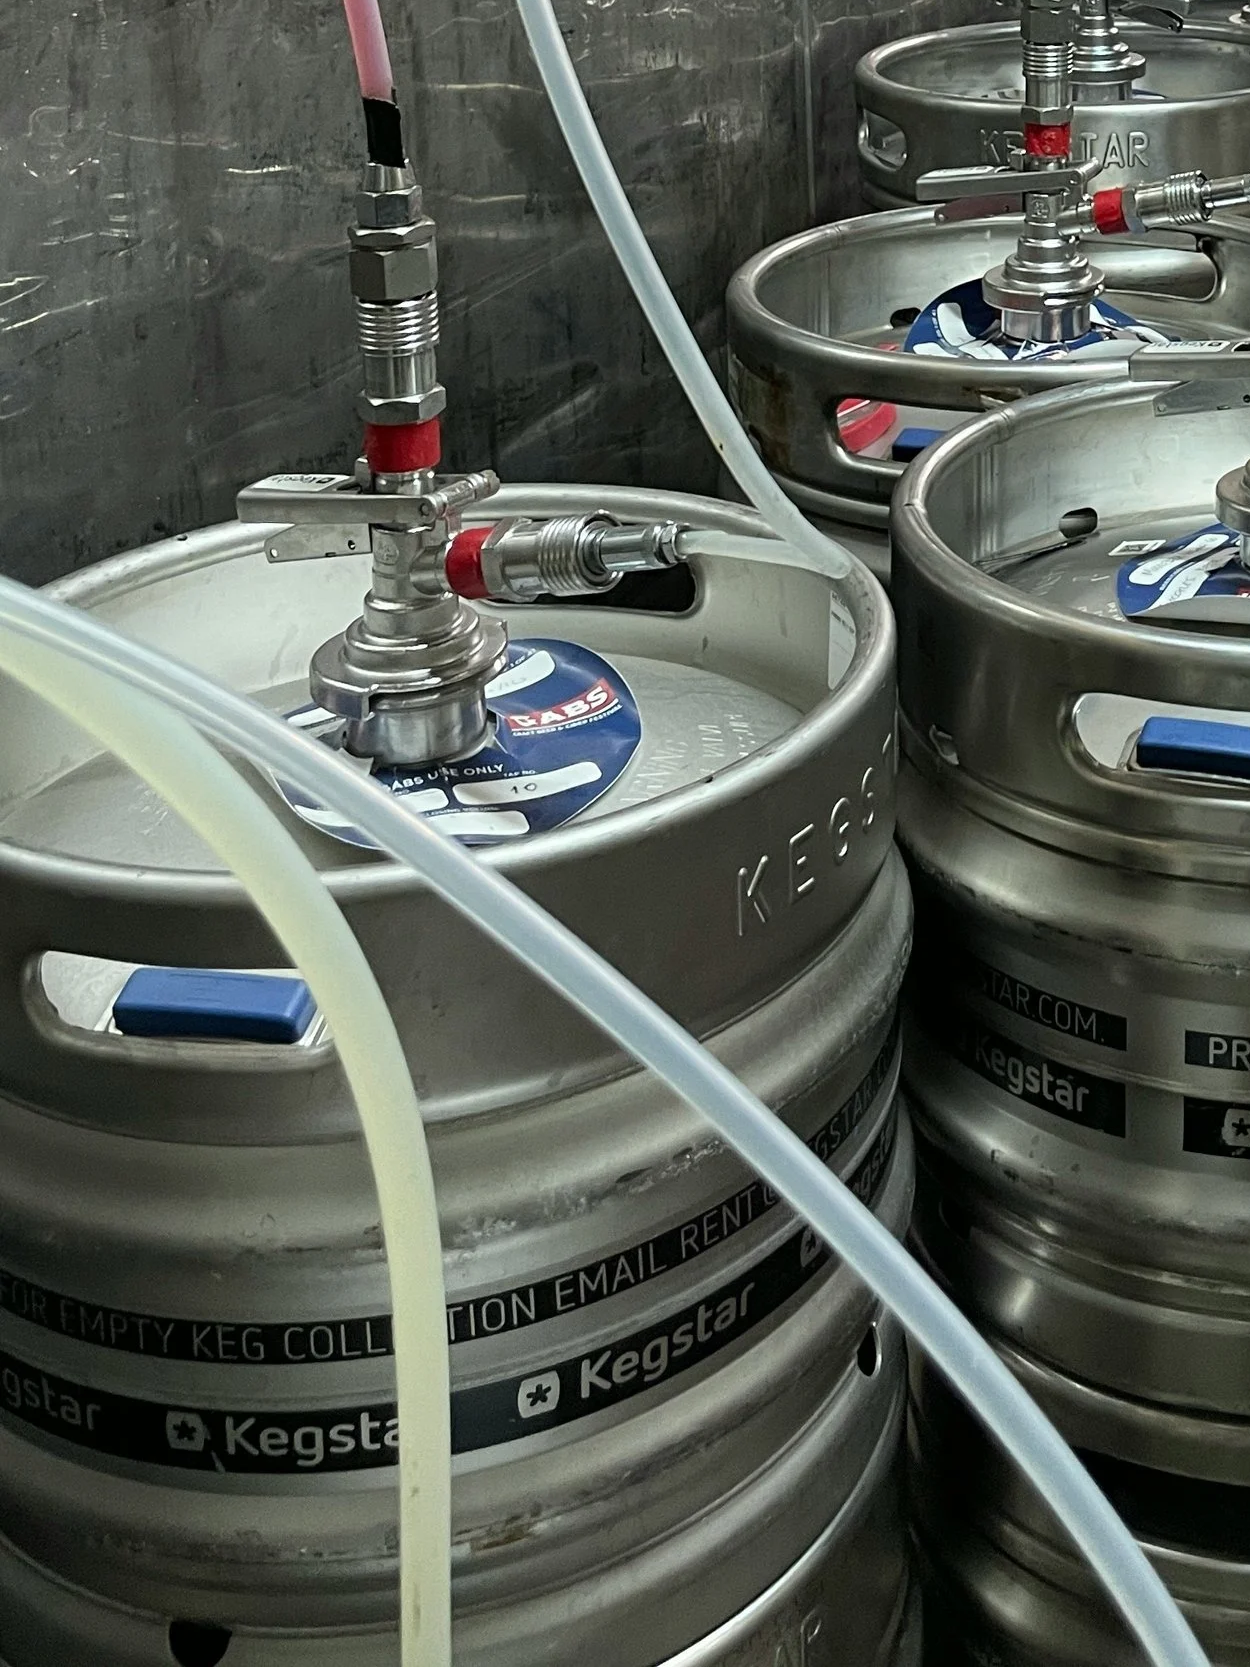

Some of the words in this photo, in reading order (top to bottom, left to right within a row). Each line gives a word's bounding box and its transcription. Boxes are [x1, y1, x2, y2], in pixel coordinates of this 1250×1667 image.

[980, 129, 1151, 170] KETAR
[509, 685, 609, 728] GABS
[463, 763, 504, 776] ONLY
[975, 1034, 1090, 1113] Kegstar
[59, 1300, 176, 1355] EMPTY
[192, 1323, 266, 1362] KEG
[554, 1247, 667, 1313] EMAIL
[579, 1280, 755, 1399] Kegstar
[0, 1367, 99, 1432] gstar
[224, 1411, 400, 1467] Kegsta
